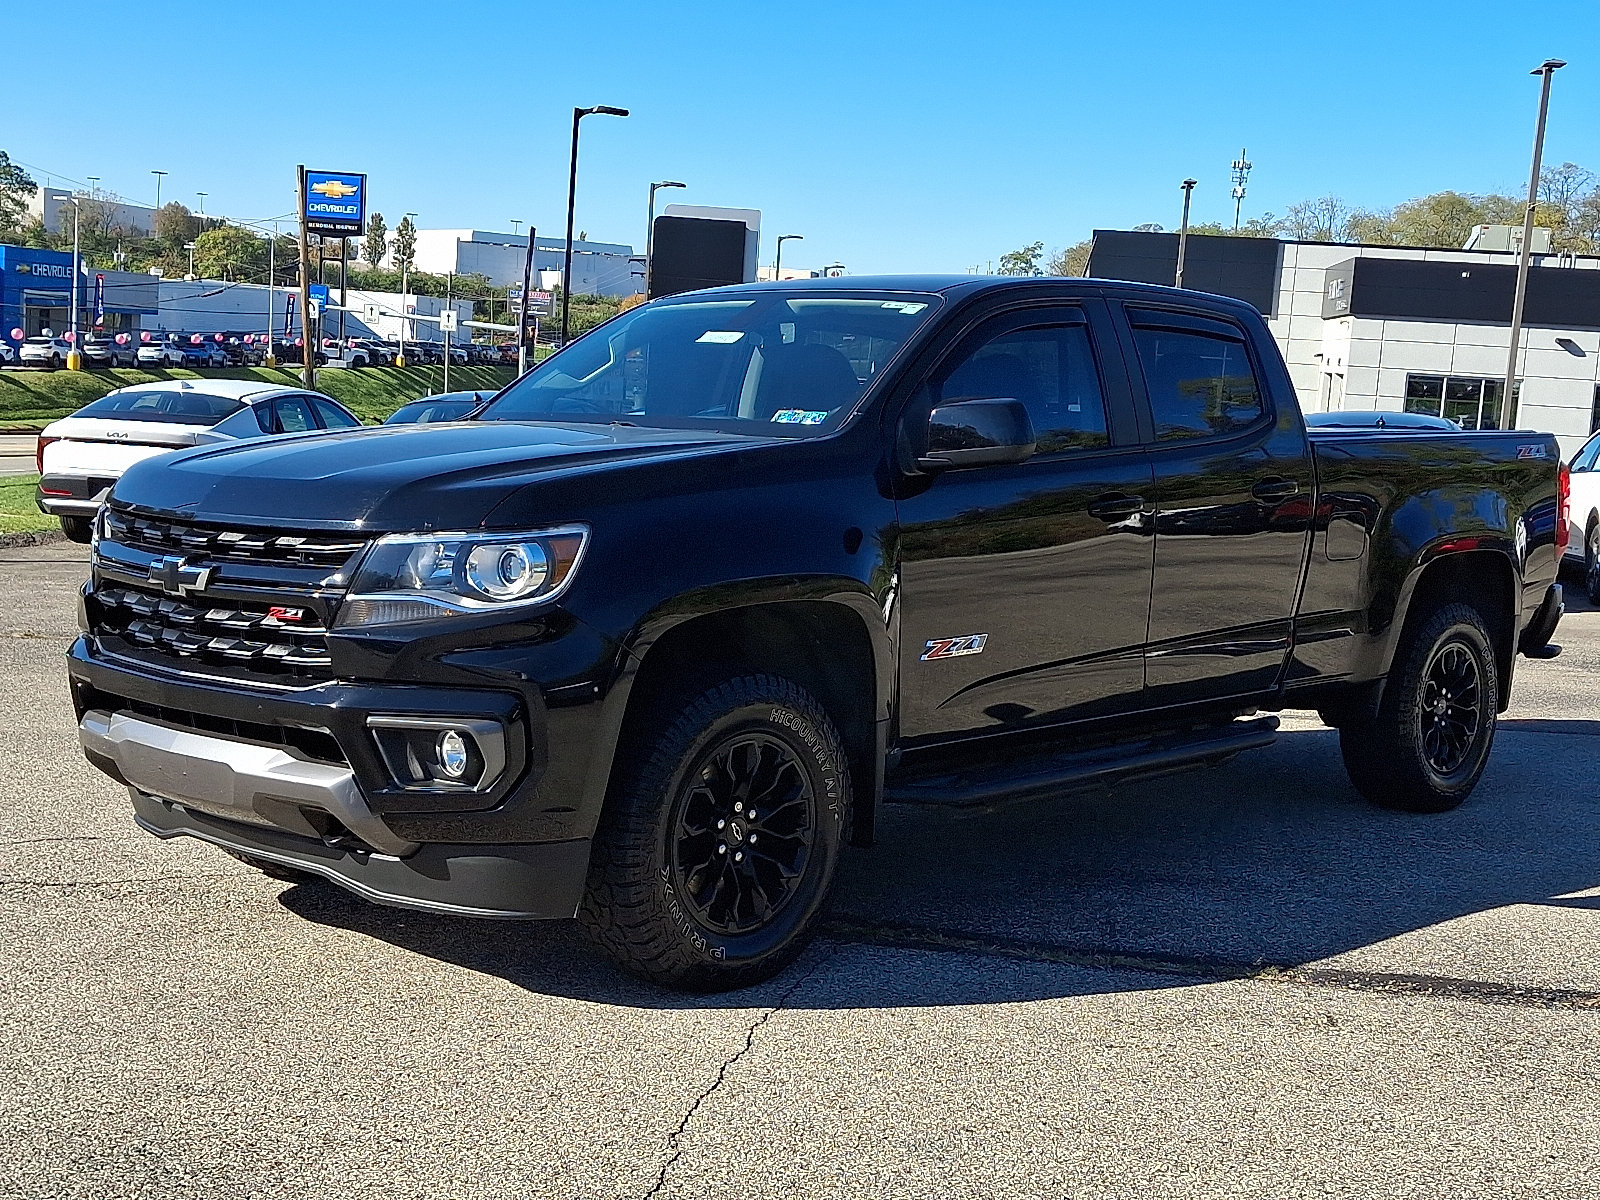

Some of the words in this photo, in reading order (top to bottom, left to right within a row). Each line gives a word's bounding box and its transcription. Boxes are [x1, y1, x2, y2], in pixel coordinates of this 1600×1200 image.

[309, 203, 358, 214] CHEVROLET
[1516, 443, 1546, 459] Z71
[268, 606, 304, 620] Z71
[920, 633, 988, 660] Z71
[769, 708, 832, 772] HiCOUNTRY
[660, 865, 726, 960] PRINX
